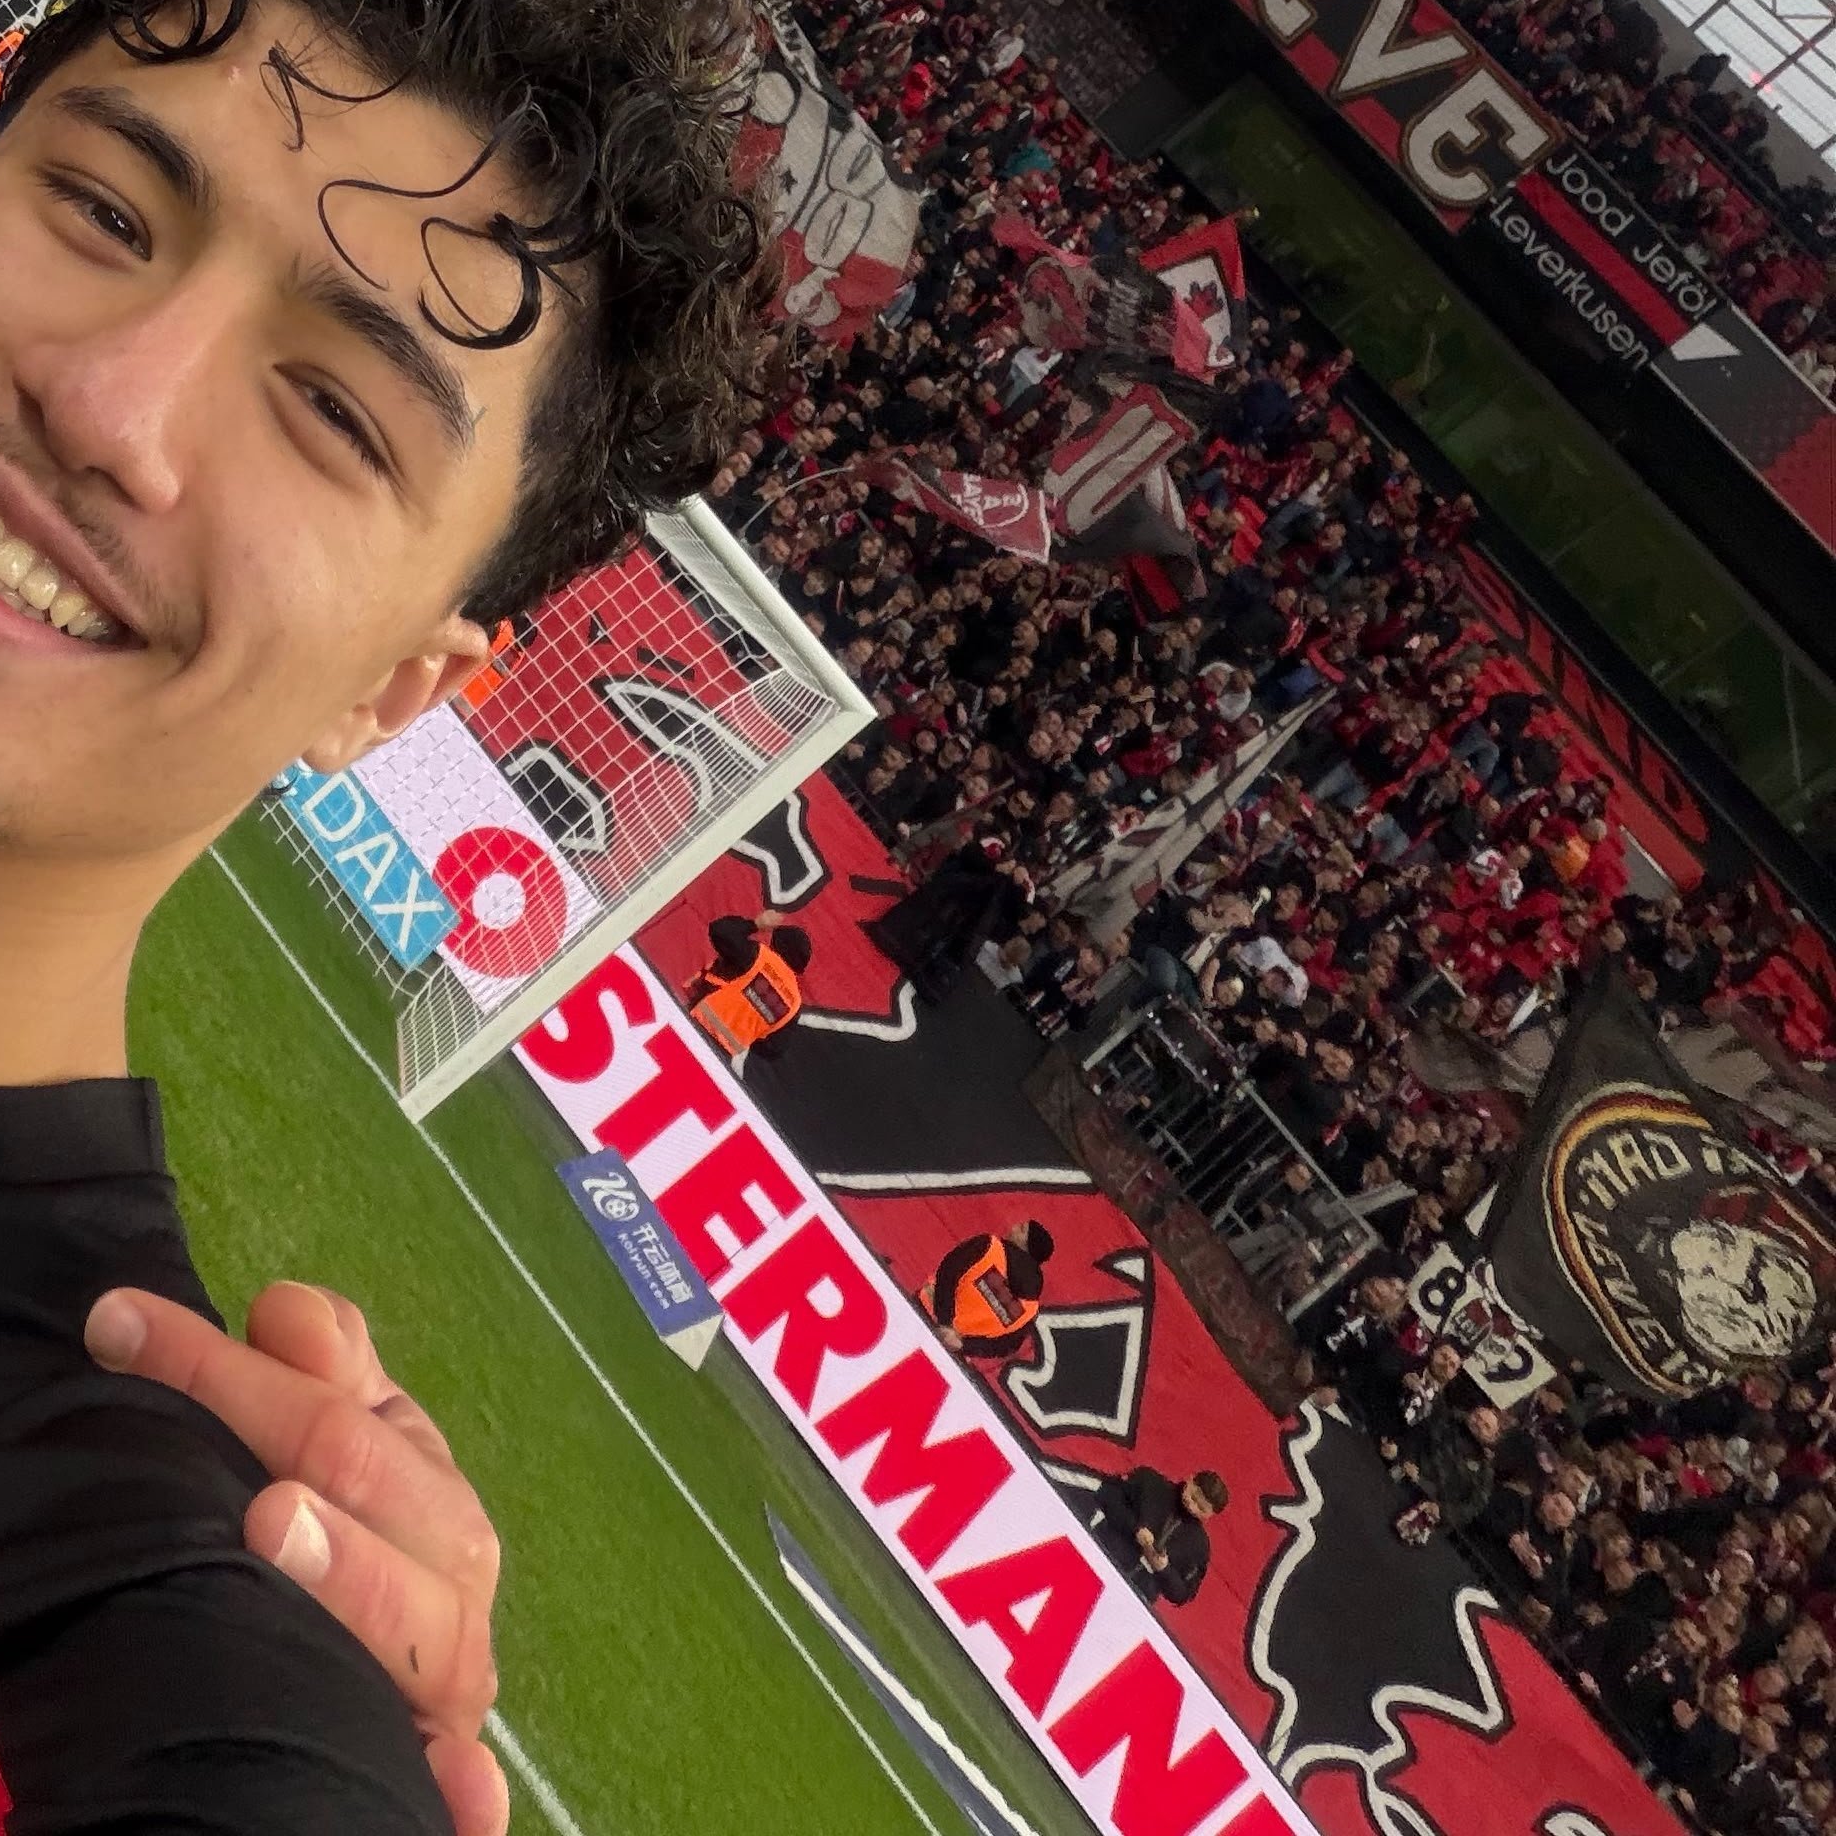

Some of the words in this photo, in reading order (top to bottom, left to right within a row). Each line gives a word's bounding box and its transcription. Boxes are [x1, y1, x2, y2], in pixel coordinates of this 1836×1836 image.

[1489, 195, 1650, 370] Leverkusen
[1546, 153, 1635, 237] Jood
[1633, 242, 1717, 321] Jeföl
[432, 826, 1299, 1836] OSTERMAN
